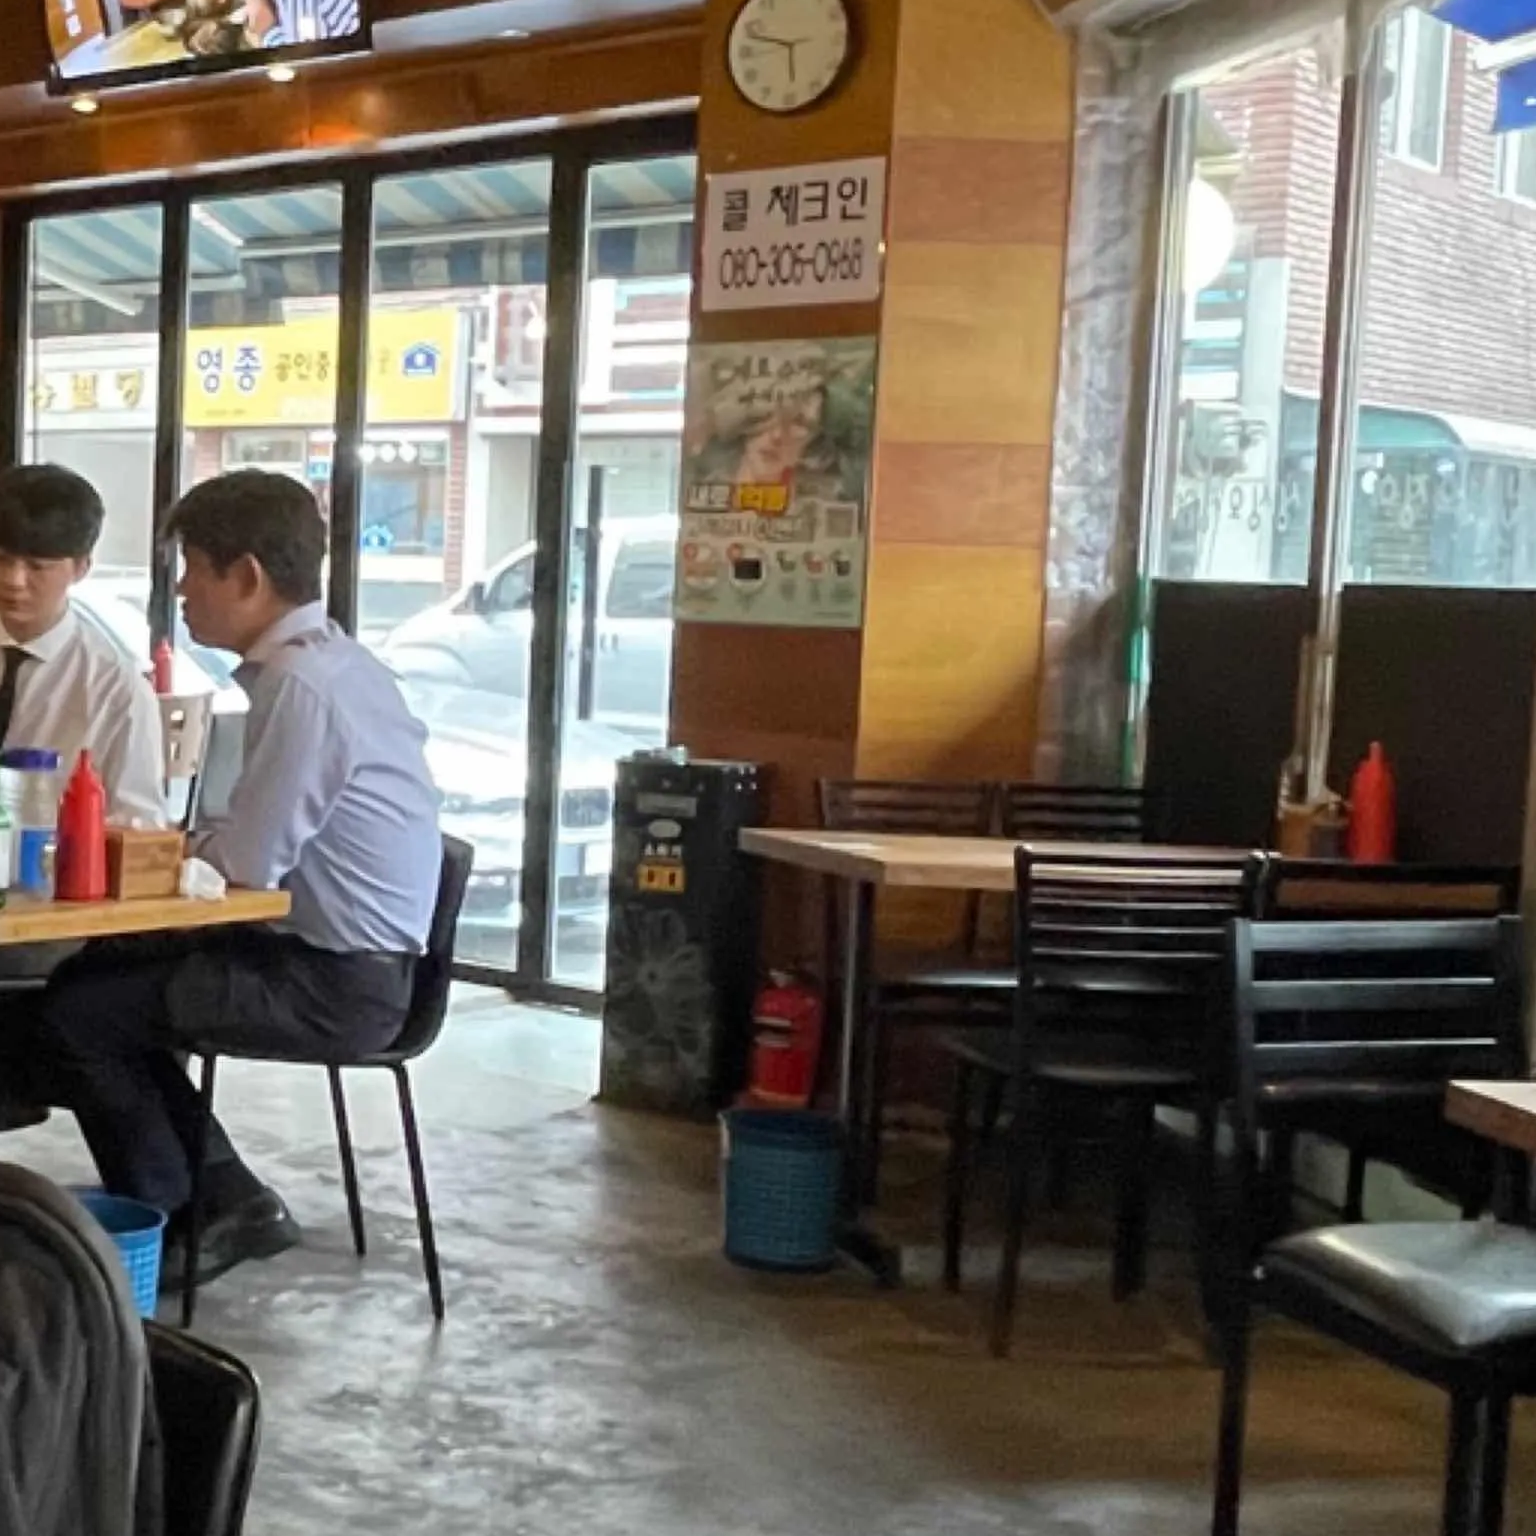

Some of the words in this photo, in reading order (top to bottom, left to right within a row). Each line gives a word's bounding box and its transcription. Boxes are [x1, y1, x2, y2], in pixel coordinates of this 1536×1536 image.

[766, 176, 869, 227] 체크인
[196, 345, 263, 394] 영종
[275, 350, 331, 382] 공인중
